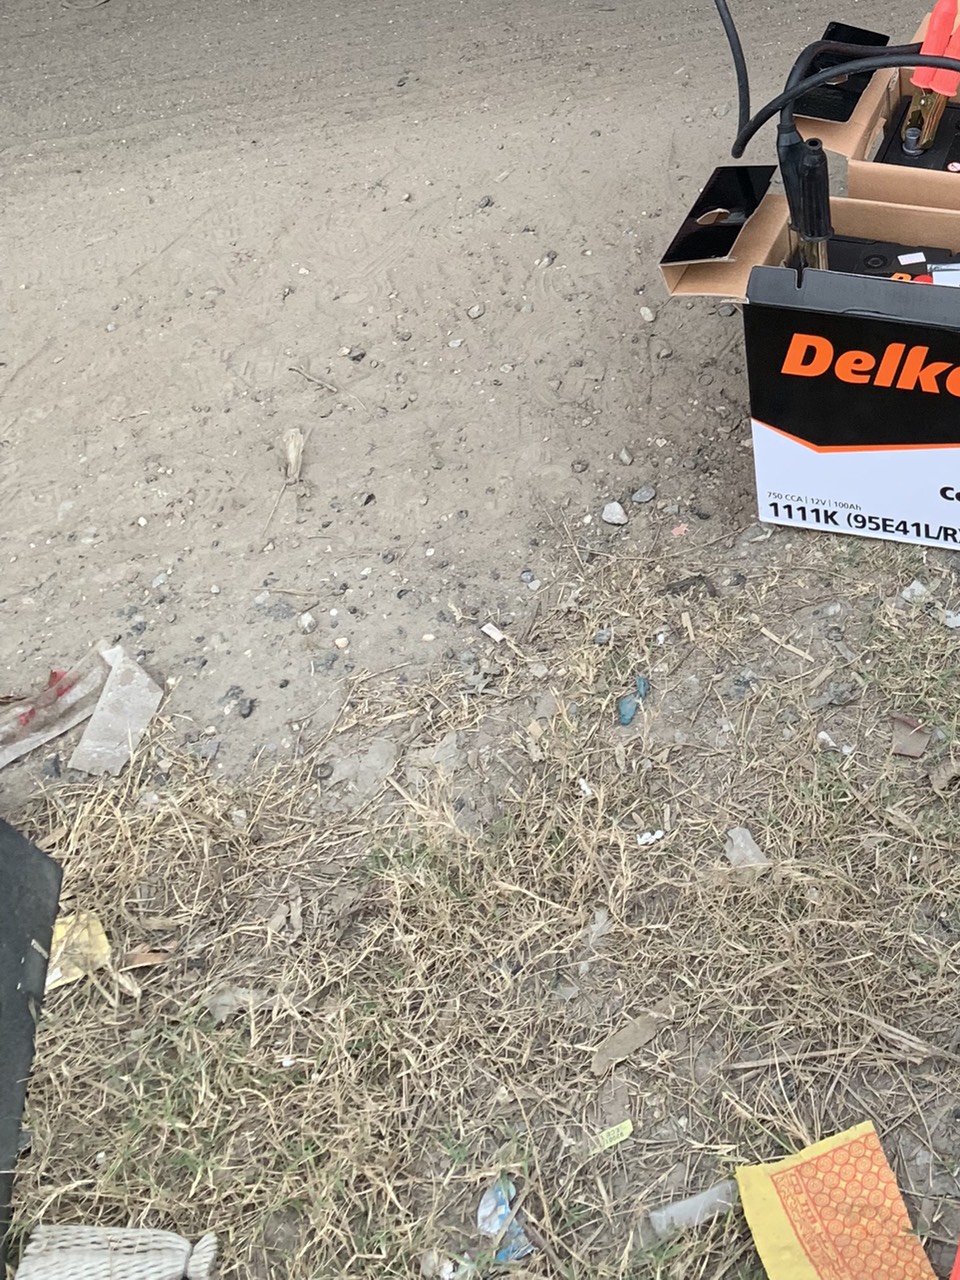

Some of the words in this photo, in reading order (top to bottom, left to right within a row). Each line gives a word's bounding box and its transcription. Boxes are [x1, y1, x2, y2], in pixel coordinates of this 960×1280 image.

[767, 491, 783, 500] 750
[784, 493, 803, 503] CCA
[810, 497, 827, 506] 12V
[834, 500, 862, 511] 100Ah
[768, 502, 840, 527] 1111K
